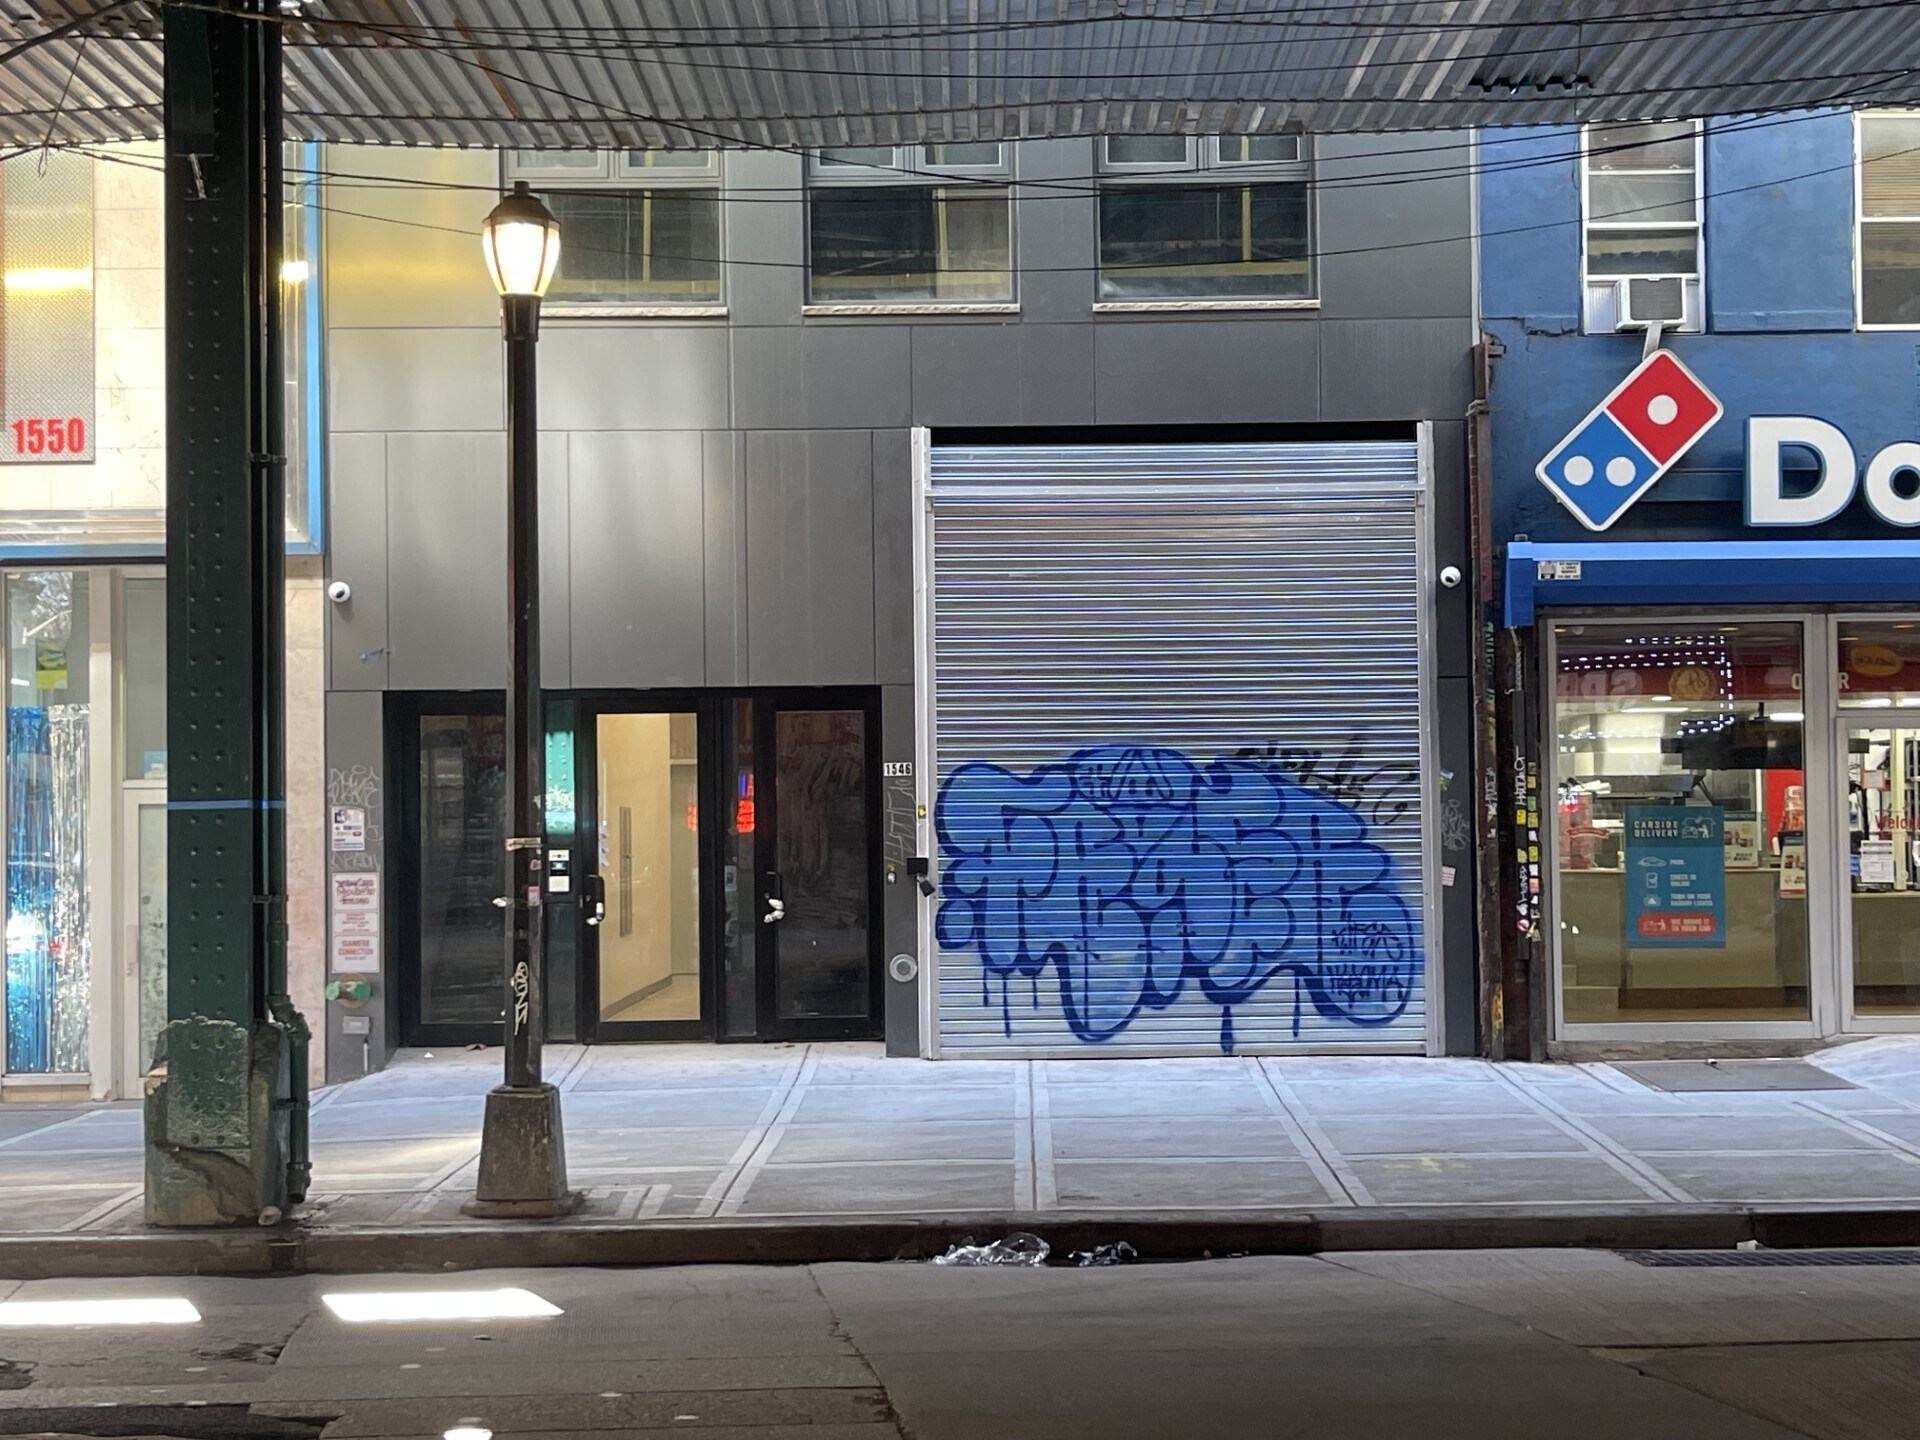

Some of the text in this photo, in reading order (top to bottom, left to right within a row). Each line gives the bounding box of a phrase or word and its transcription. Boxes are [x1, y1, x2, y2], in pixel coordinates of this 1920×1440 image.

[11, 417, 85, 454] 1550
[1743, 415, 1920, 527] Do
[885, 763, 912, 775] 1546
[1633, 820, 1678, 829] CARSIDE
[1633, 829, 1678, 838] DELIVERY
